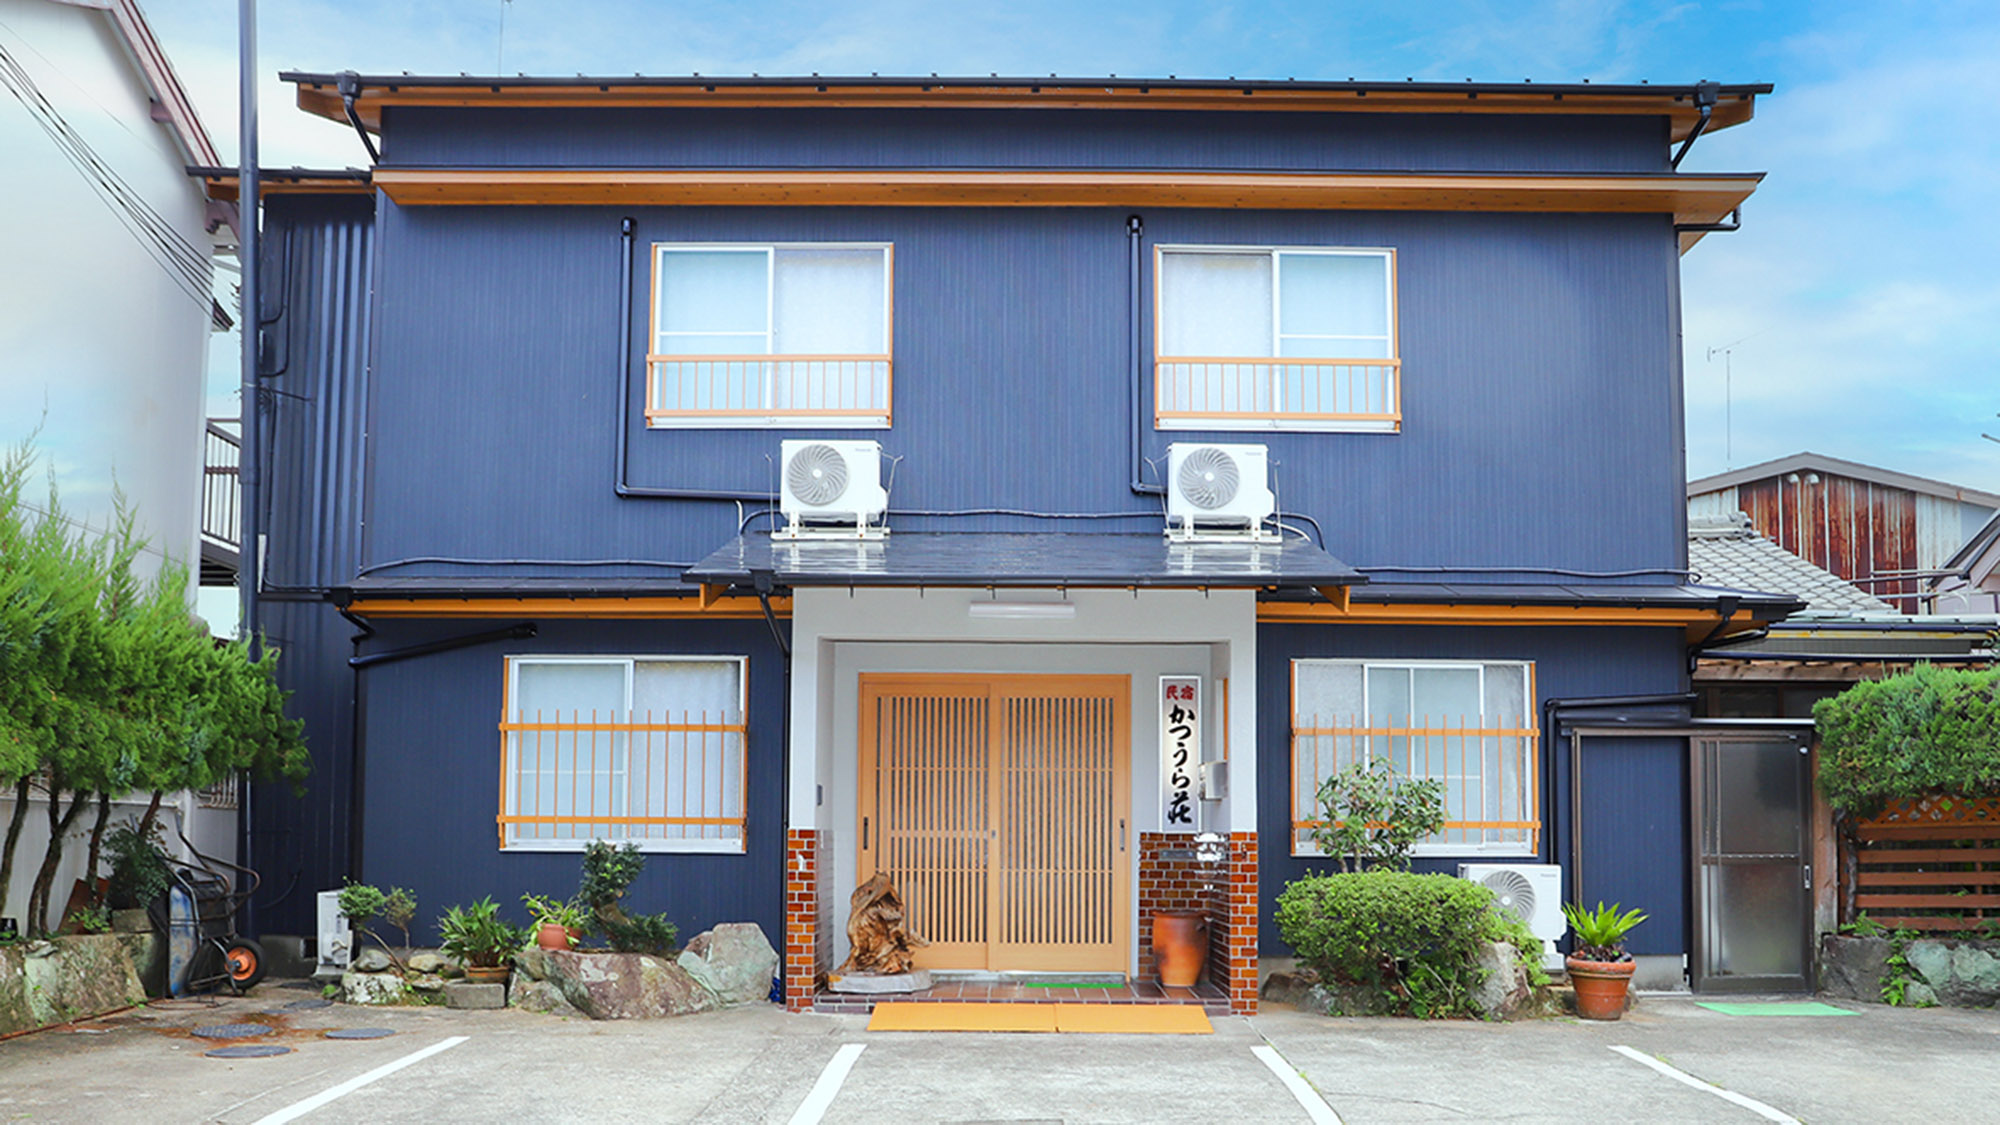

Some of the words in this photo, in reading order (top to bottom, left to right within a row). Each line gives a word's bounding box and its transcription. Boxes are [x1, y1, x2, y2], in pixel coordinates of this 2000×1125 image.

[1166, 685, 1195, 700] 民宿
[1168, 704, 1195, 824] かつうら荘
